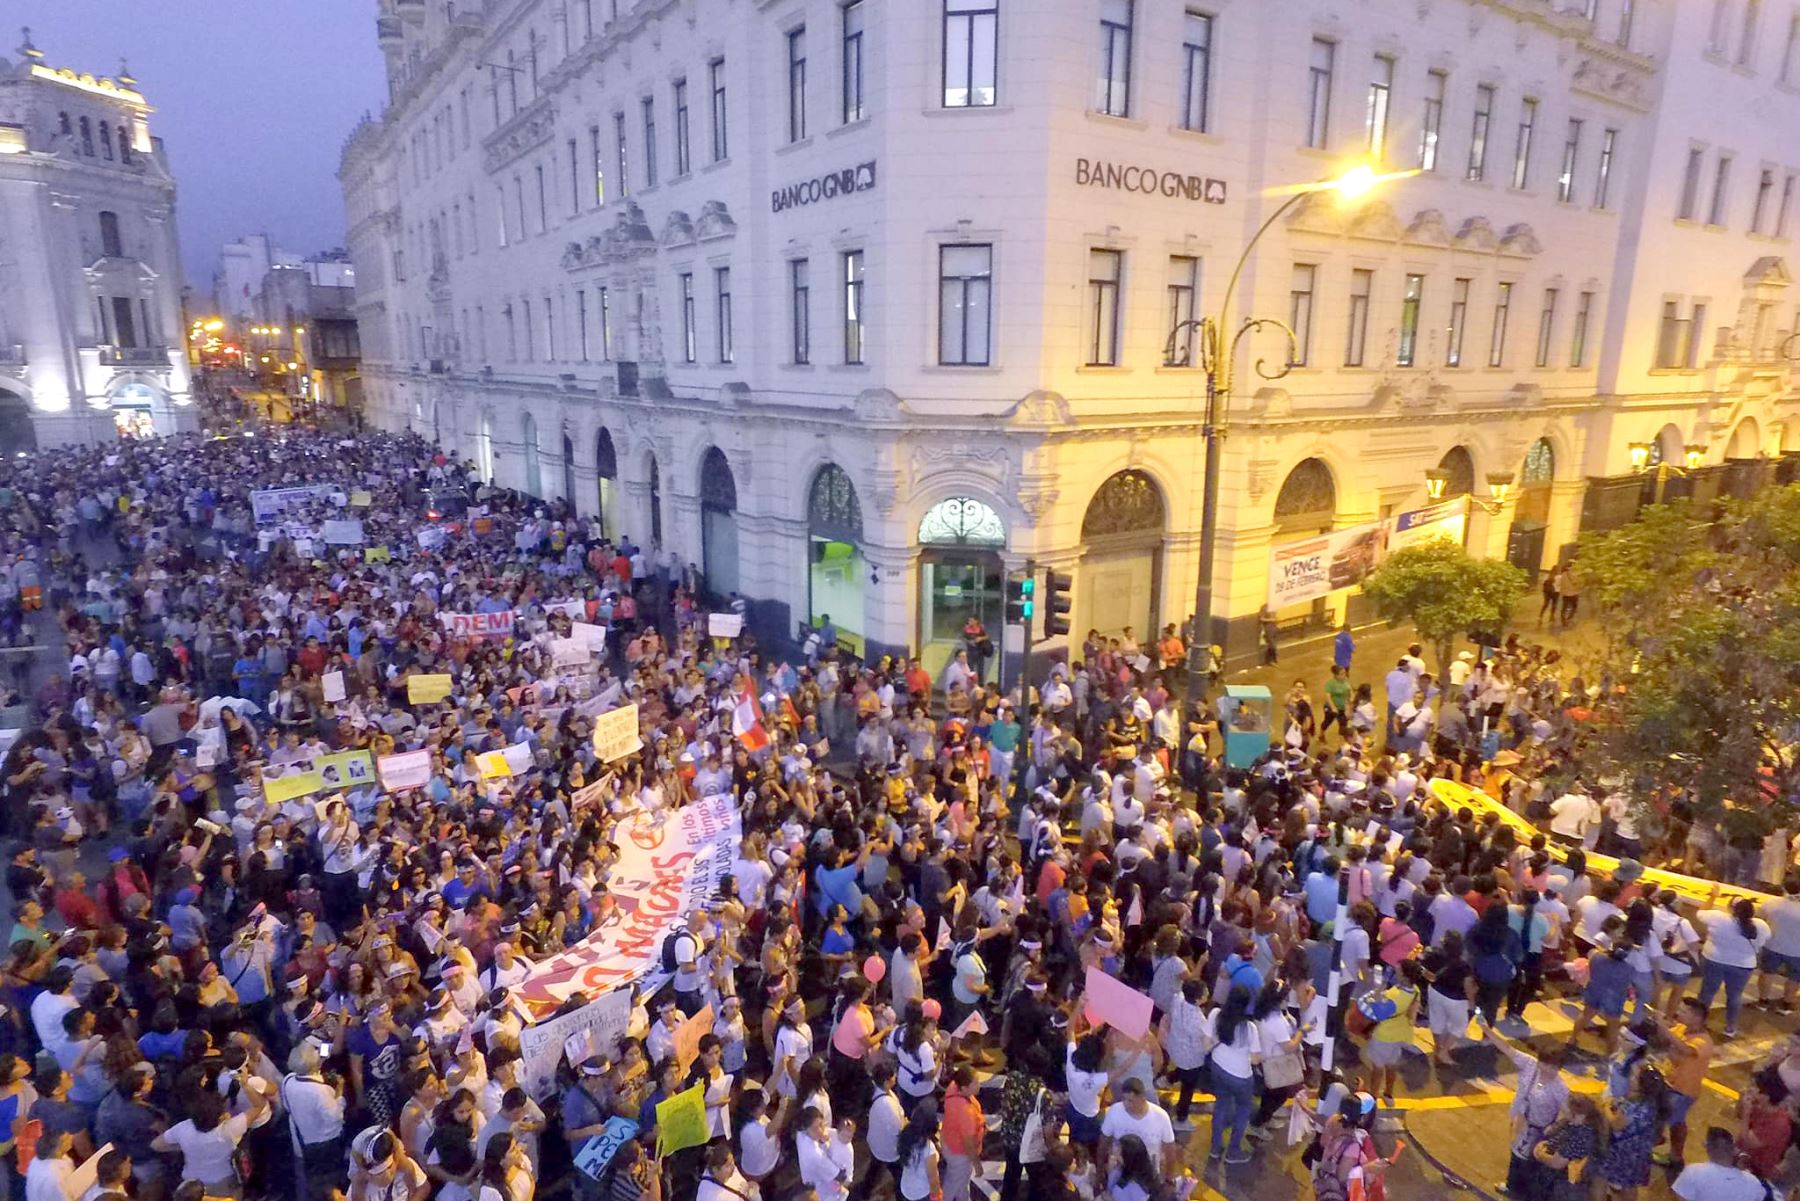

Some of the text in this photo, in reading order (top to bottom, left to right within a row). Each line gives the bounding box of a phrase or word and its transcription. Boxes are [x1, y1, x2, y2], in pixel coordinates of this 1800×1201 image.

[772, 169, 855, 213] BANCO GNB
[1076, 158, 1202, 201] BANCO GNB
[1283, 556, 1321, 577] VENCE
[687, 831, 701, 845] En
